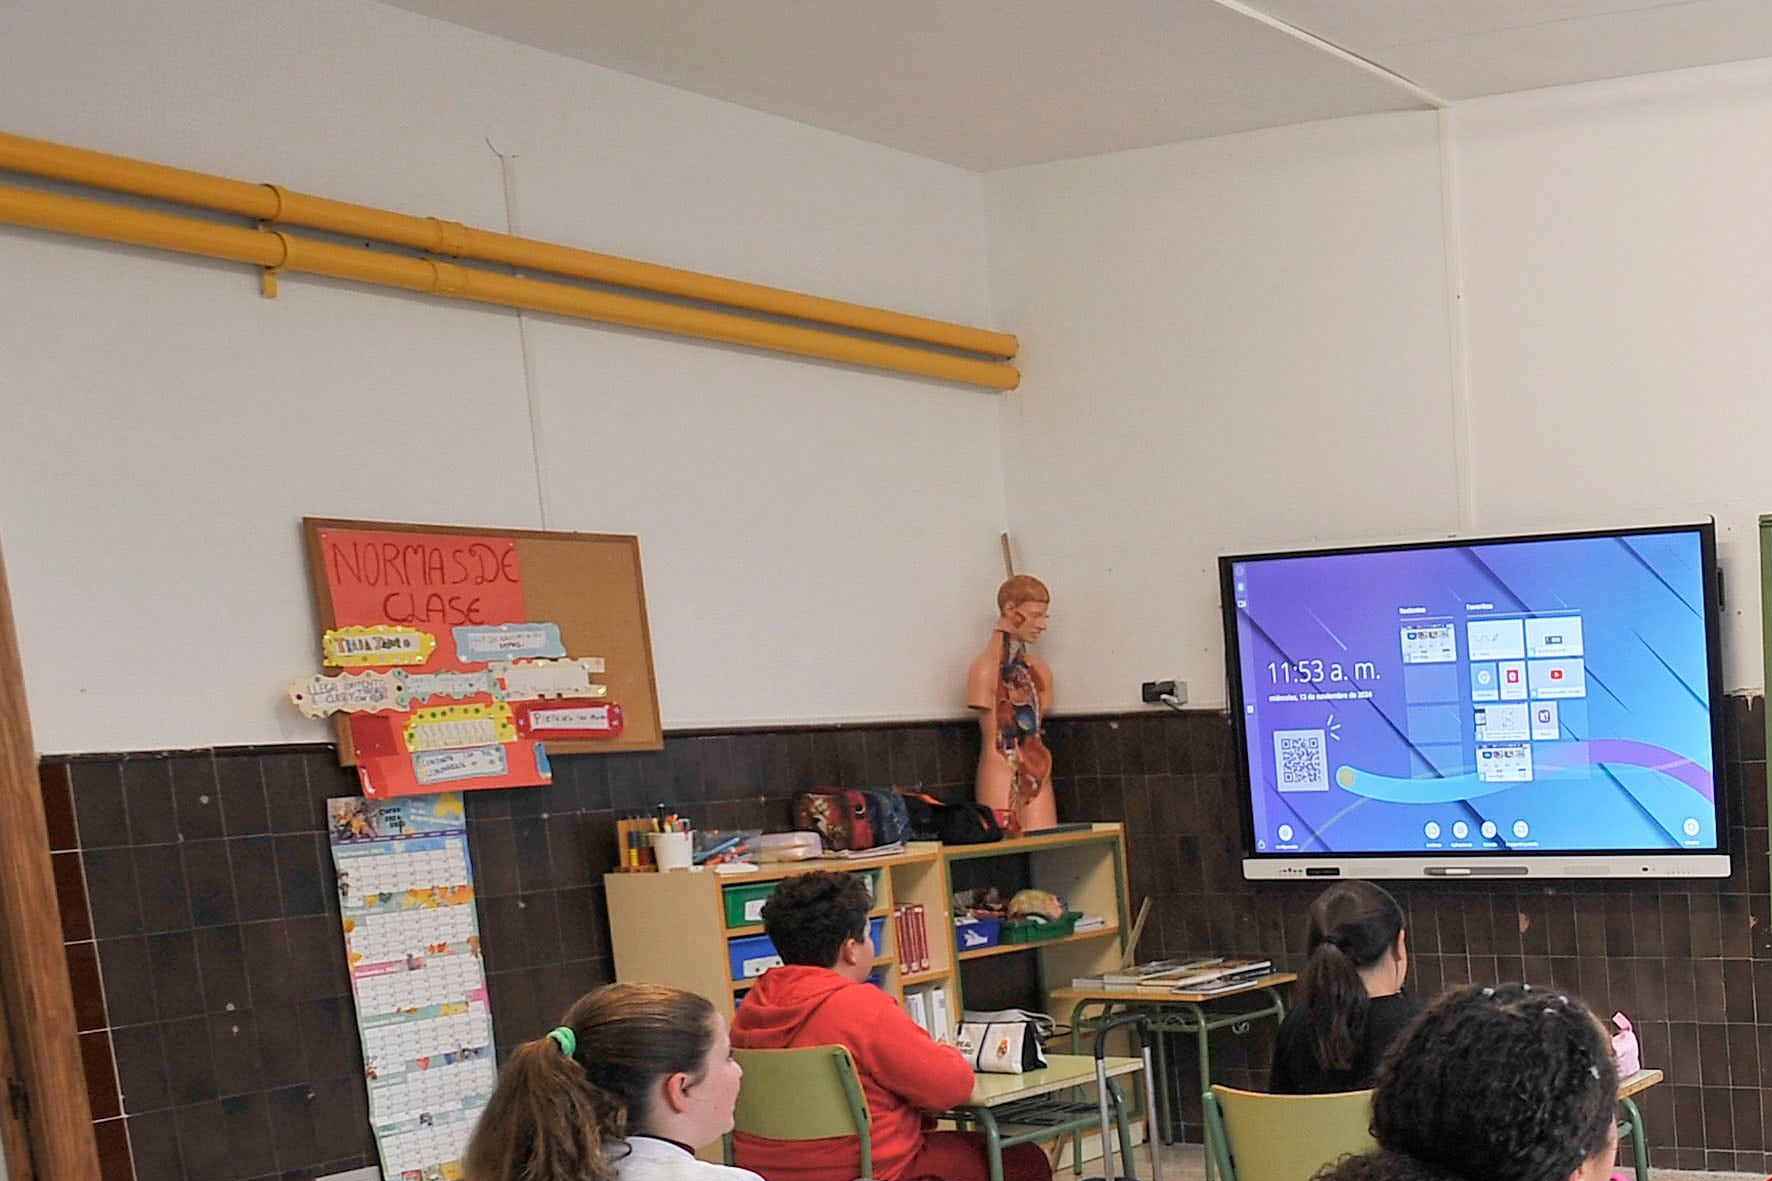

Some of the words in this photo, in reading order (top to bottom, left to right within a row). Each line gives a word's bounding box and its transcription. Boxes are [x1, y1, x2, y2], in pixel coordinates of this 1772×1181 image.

[332, 541, 468, 586] NORMAS
[469, 543, 520, 585] DE
[383, 592, 485, 626] CLASE
[1267, 659, 1324, 684] 11:53
[1330, 663, 1349, 682] a.
[1354, 662, 1381, 681] m.
